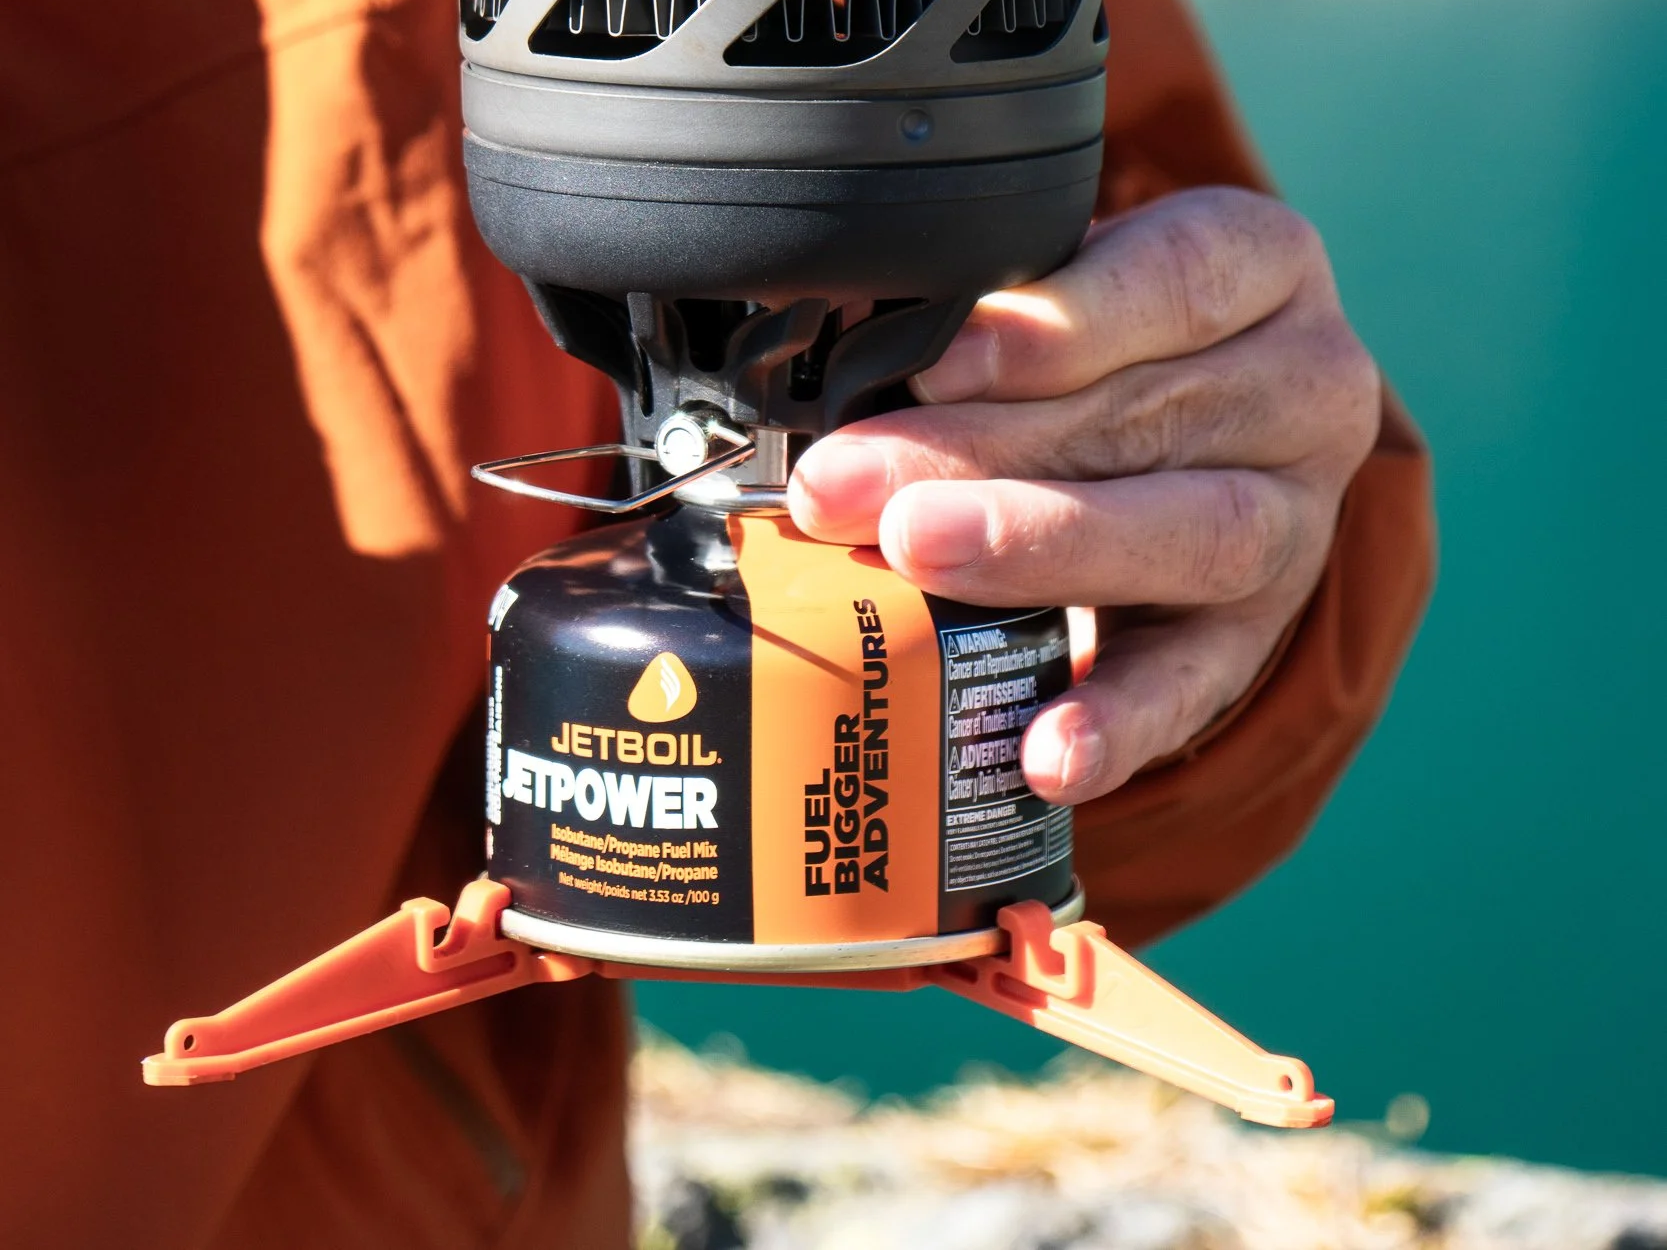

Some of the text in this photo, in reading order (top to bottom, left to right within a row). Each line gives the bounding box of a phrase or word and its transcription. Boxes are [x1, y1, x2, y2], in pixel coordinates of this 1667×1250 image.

[956, 628, 1008, 653] WARNING:
[949, 658, 974, 681] Cancer
[974, 655, 987, 678] and
[961, 674, 1038, 710] AVERTISSEMENT:
[949, 714, 973, 739] Cancer
[852, 597, 890, 893] ADVENTURES
[502, 748, 719, 830] JETPOWER
[833, 711, 861, 894] BIGGER
[804, 767, 832, 897] FUEL
[945, 812, 986, 827] EXTREME
[986, 803, 1017, 820] DANGER
[551, 823, 718, 859] Isobutane/Propane Fuel Mix
[550, 843, 719, 884] Mélange Isobutane/Propane
[558, 871, 720, 906] Net weight/poids net 3.53 oz /100 g
